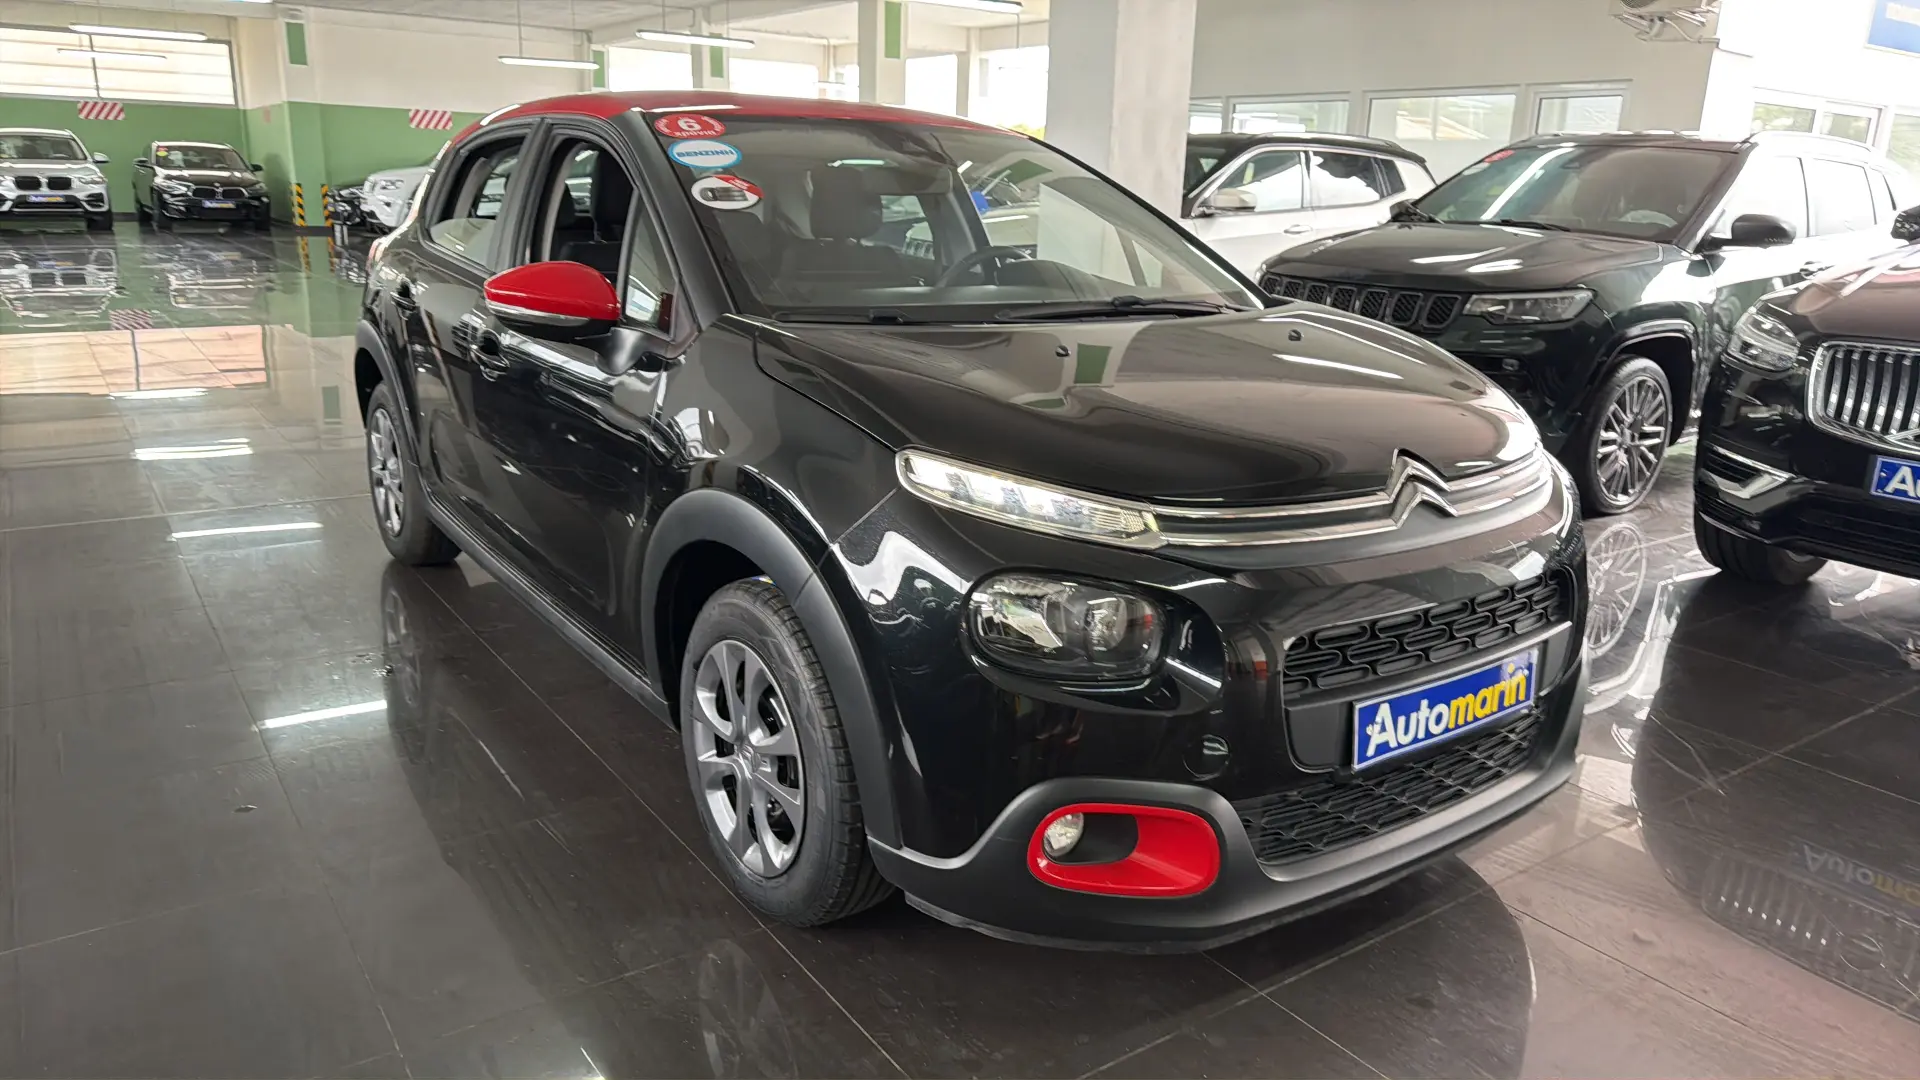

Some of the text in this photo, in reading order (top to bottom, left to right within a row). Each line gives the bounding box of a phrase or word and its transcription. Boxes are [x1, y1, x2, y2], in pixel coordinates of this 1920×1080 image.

[677, 116, 702, 131] 6
[1883, 465, 1920, 498] A
[1366, 663, 1528, 757] Automarin
